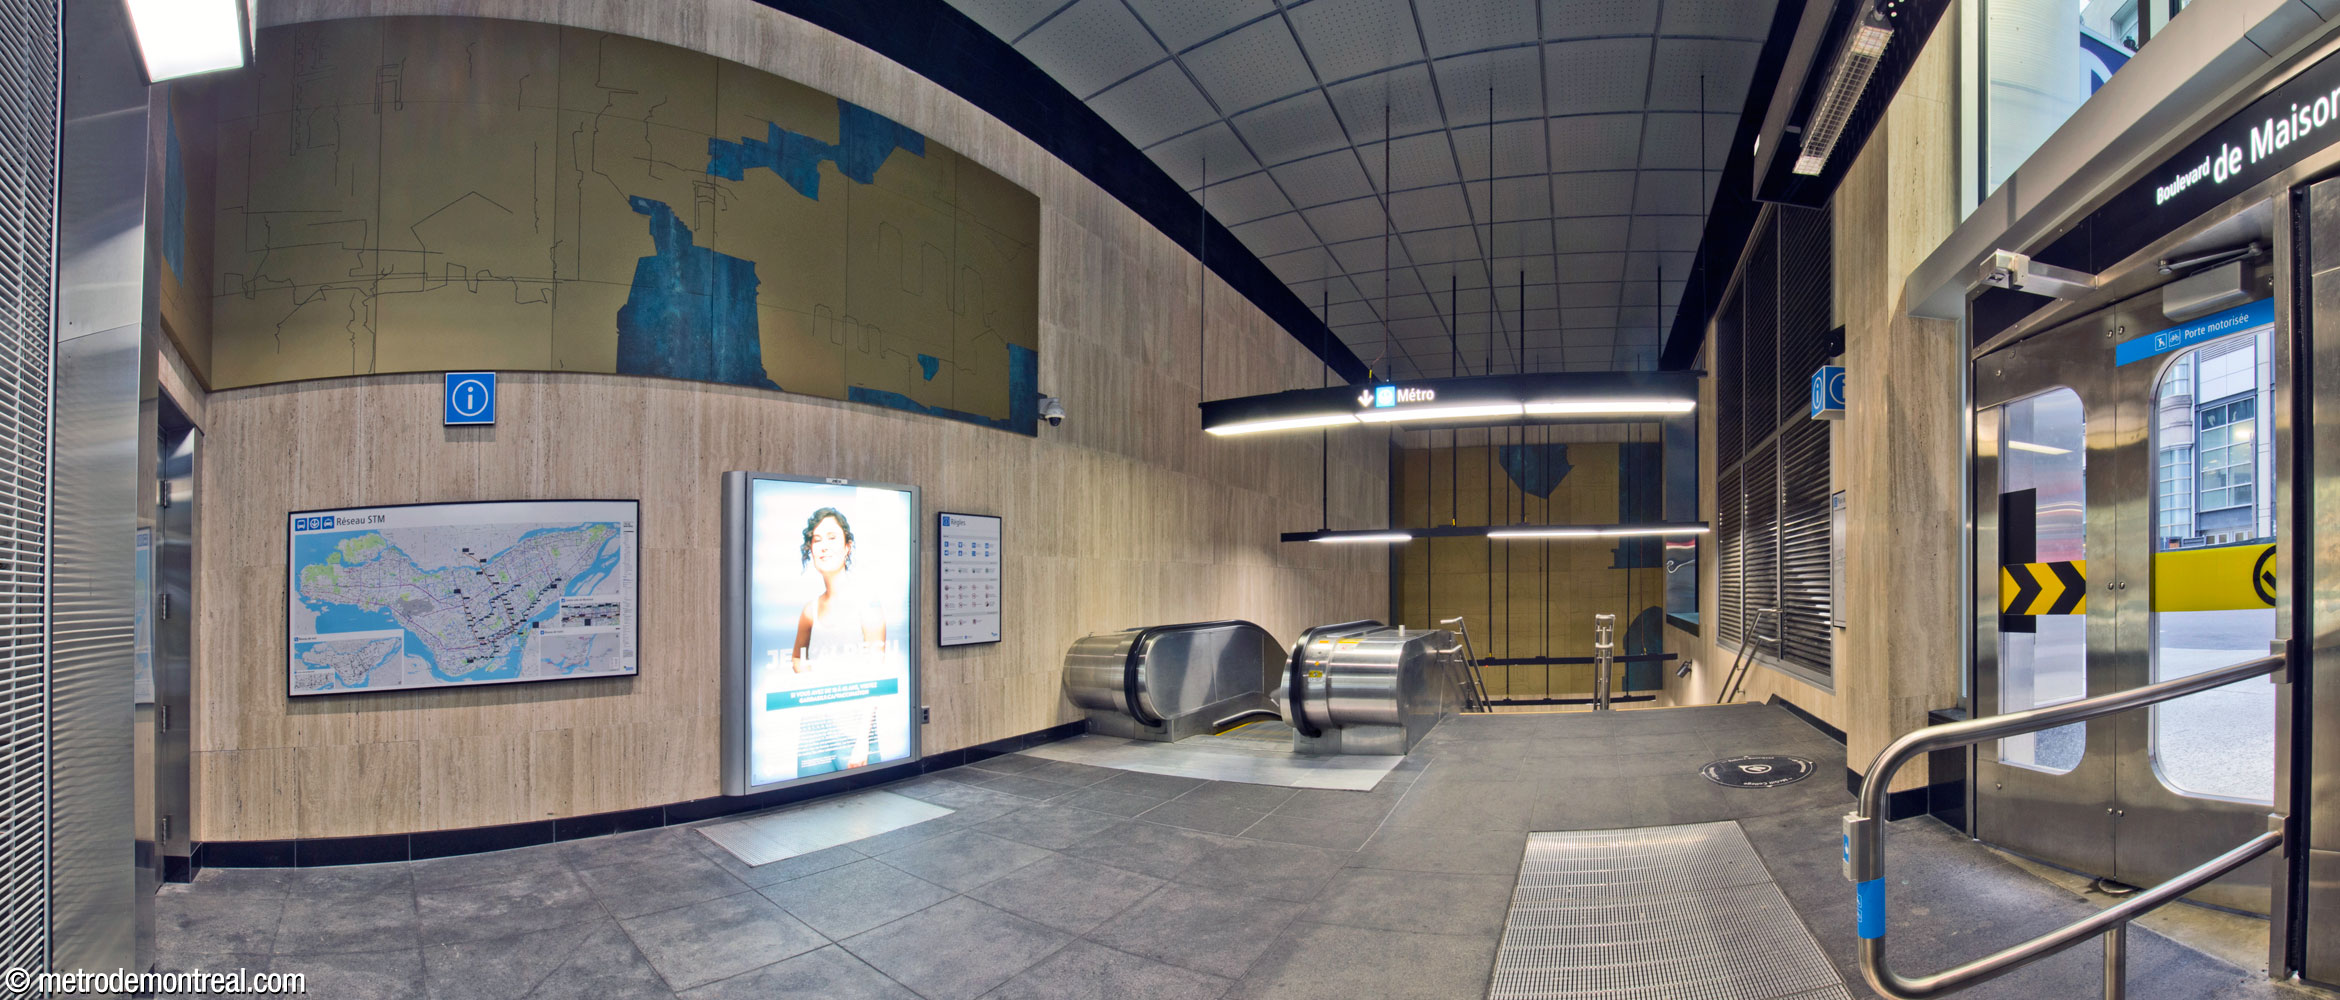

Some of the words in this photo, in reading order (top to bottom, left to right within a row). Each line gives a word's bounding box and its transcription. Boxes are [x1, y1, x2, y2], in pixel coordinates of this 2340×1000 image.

[2156, 154, 2210, 206] Boulevard
[2213, 142, 2243, 184] de
[2184, 326, 2206, 340] Porte
[2208, 313, 2250, 333] motorisée
[1396, 387, 1436, 403] Métro
[336, 516, 366, 526] Réseau
[367, 514, 386, 524] STM
